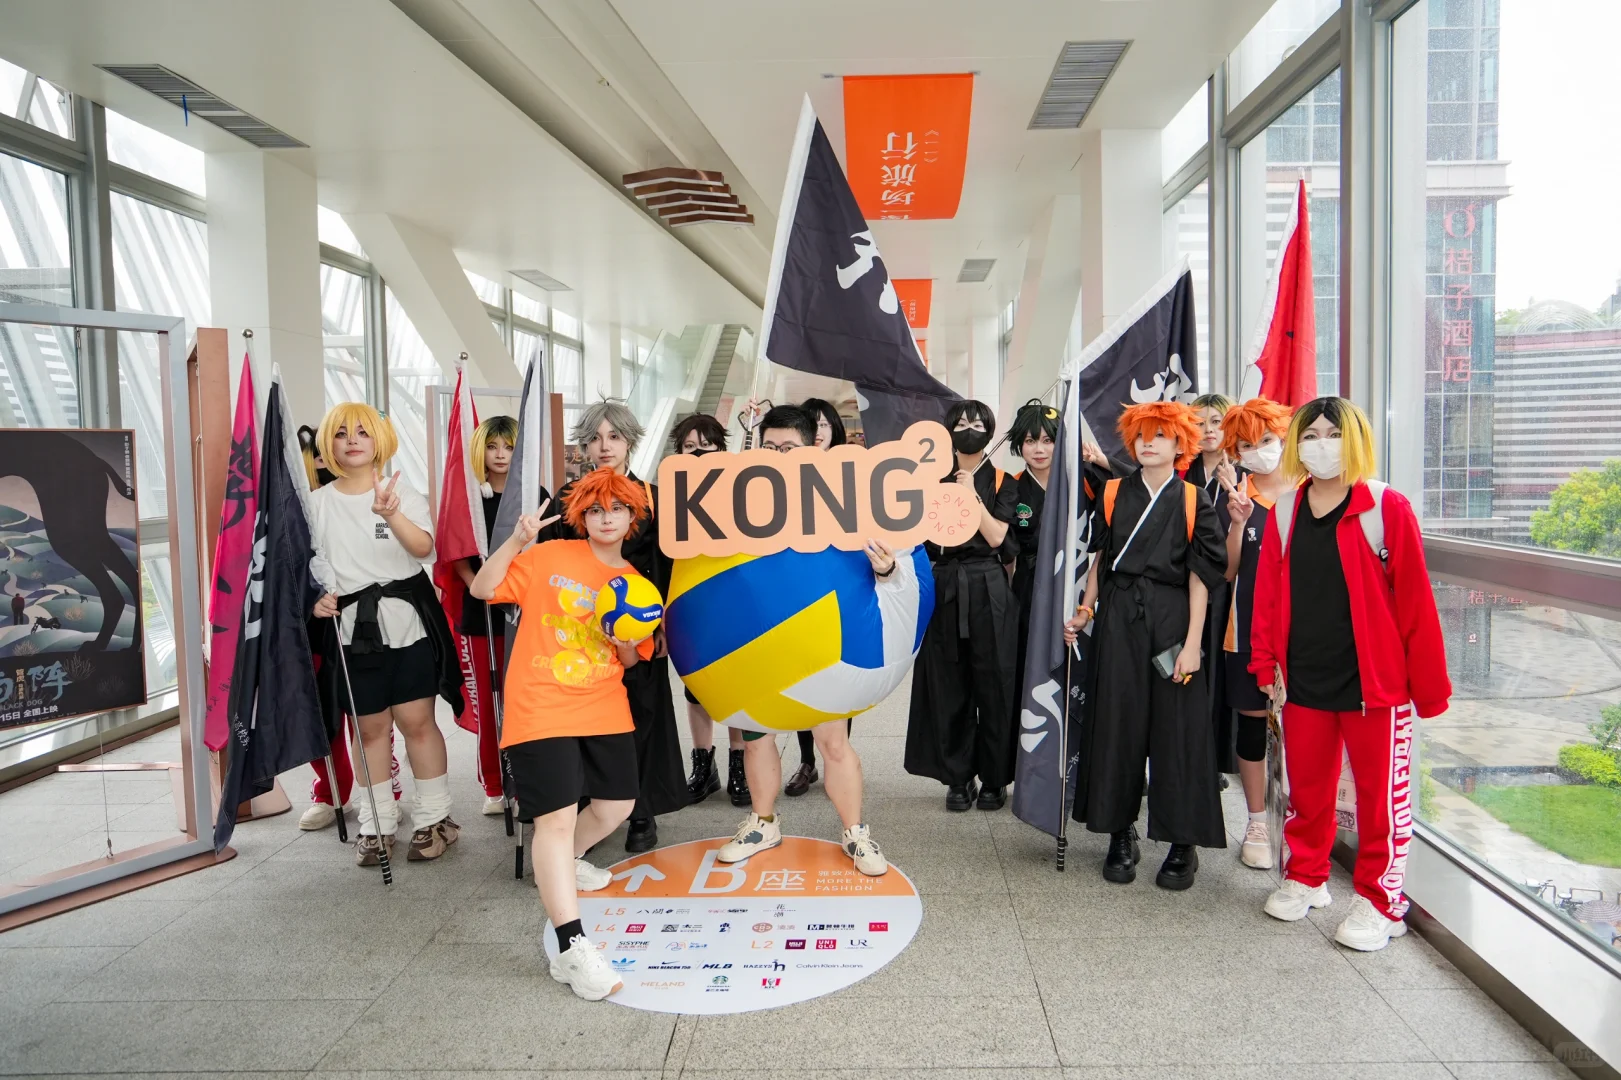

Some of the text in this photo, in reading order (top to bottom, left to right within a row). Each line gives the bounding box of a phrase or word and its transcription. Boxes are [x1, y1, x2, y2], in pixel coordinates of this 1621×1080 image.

[1443, 248, 1473, 382] 桔子酒店
[27, 699, 43, 707] DOG
[23, 705, 59, 718] 全国上映
[603, 907, 627, 916] L5
[594, 923, 616, 932] L4
[751, 940, 774, 949] L2
[850, 939, 868, 947] UR
